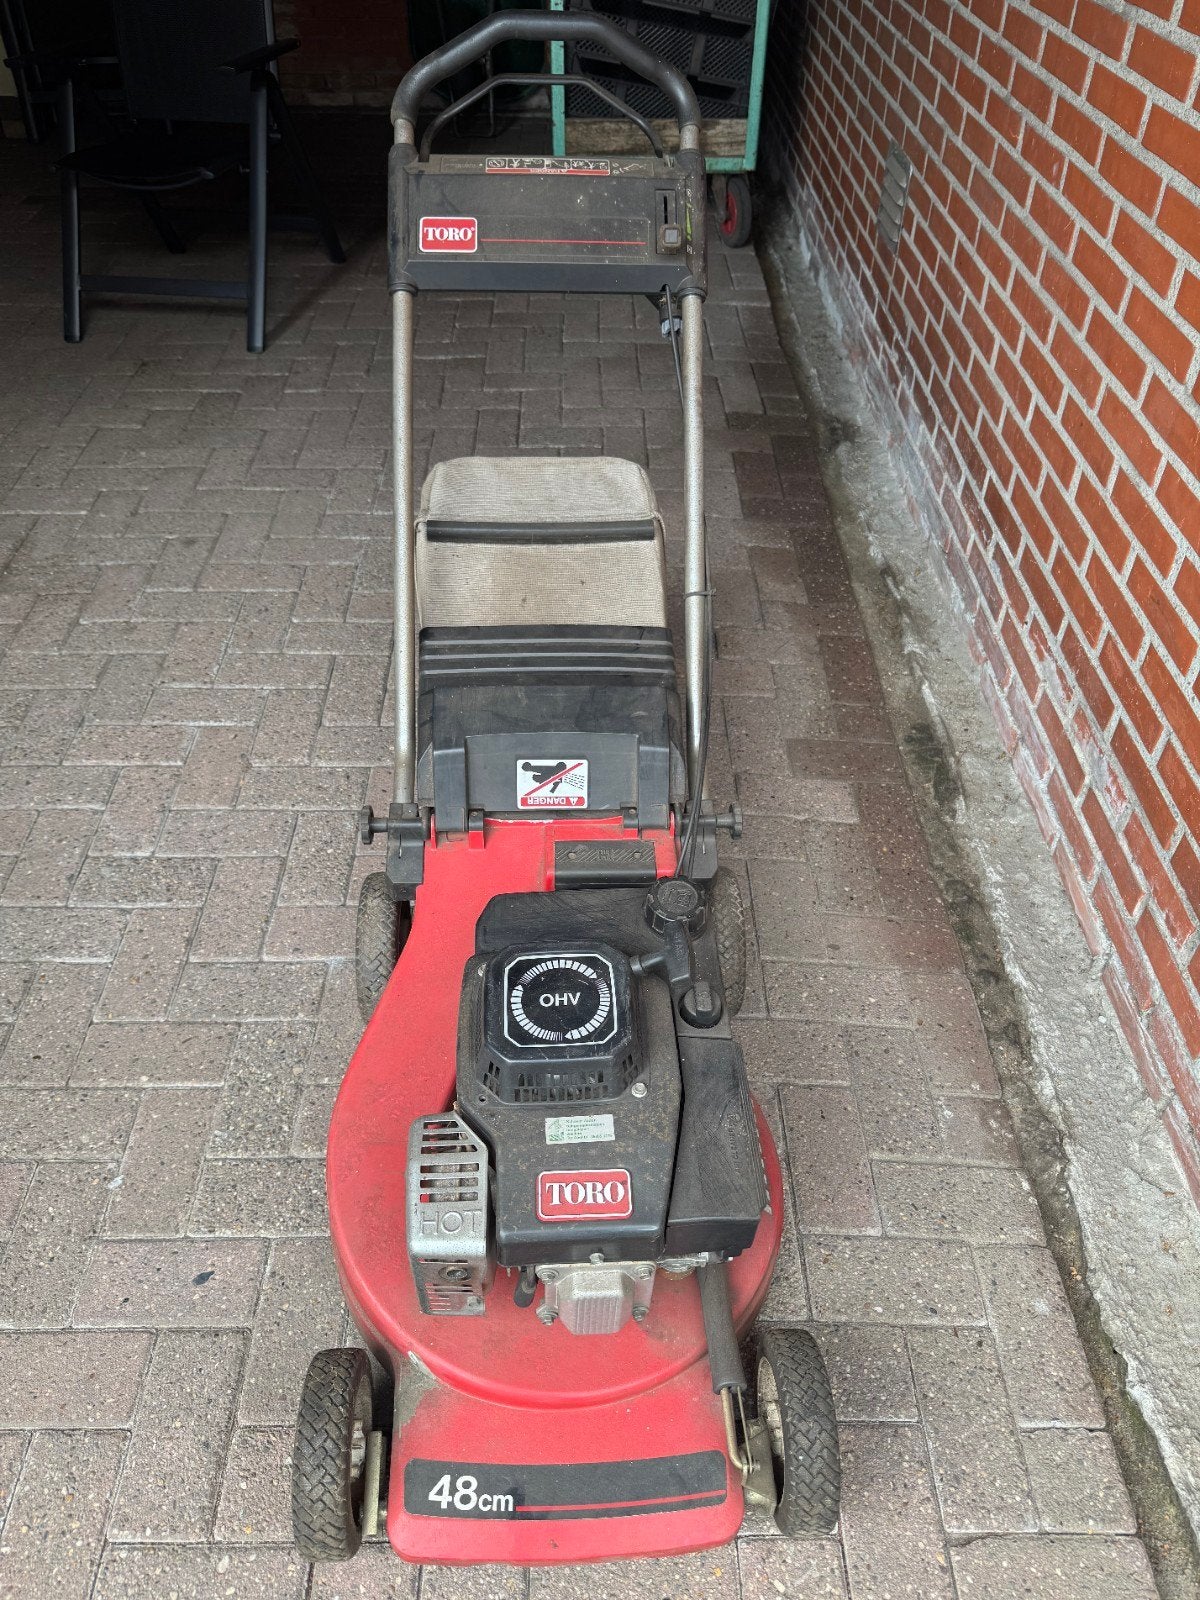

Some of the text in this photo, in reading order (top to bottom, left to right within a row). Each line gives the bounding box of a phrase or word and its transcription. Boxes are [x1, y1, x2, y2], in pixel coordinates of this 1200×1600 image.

[423, 226, 473, 241] TORO
[527, 796, 566, 805] DANGER
[539, 992, 581, 1008] OHV
[545, 1180, 625, 1206] TORO
[421, 1208, 482, 1235] HOT
[427, 1474, 514, 1512] 48cm
